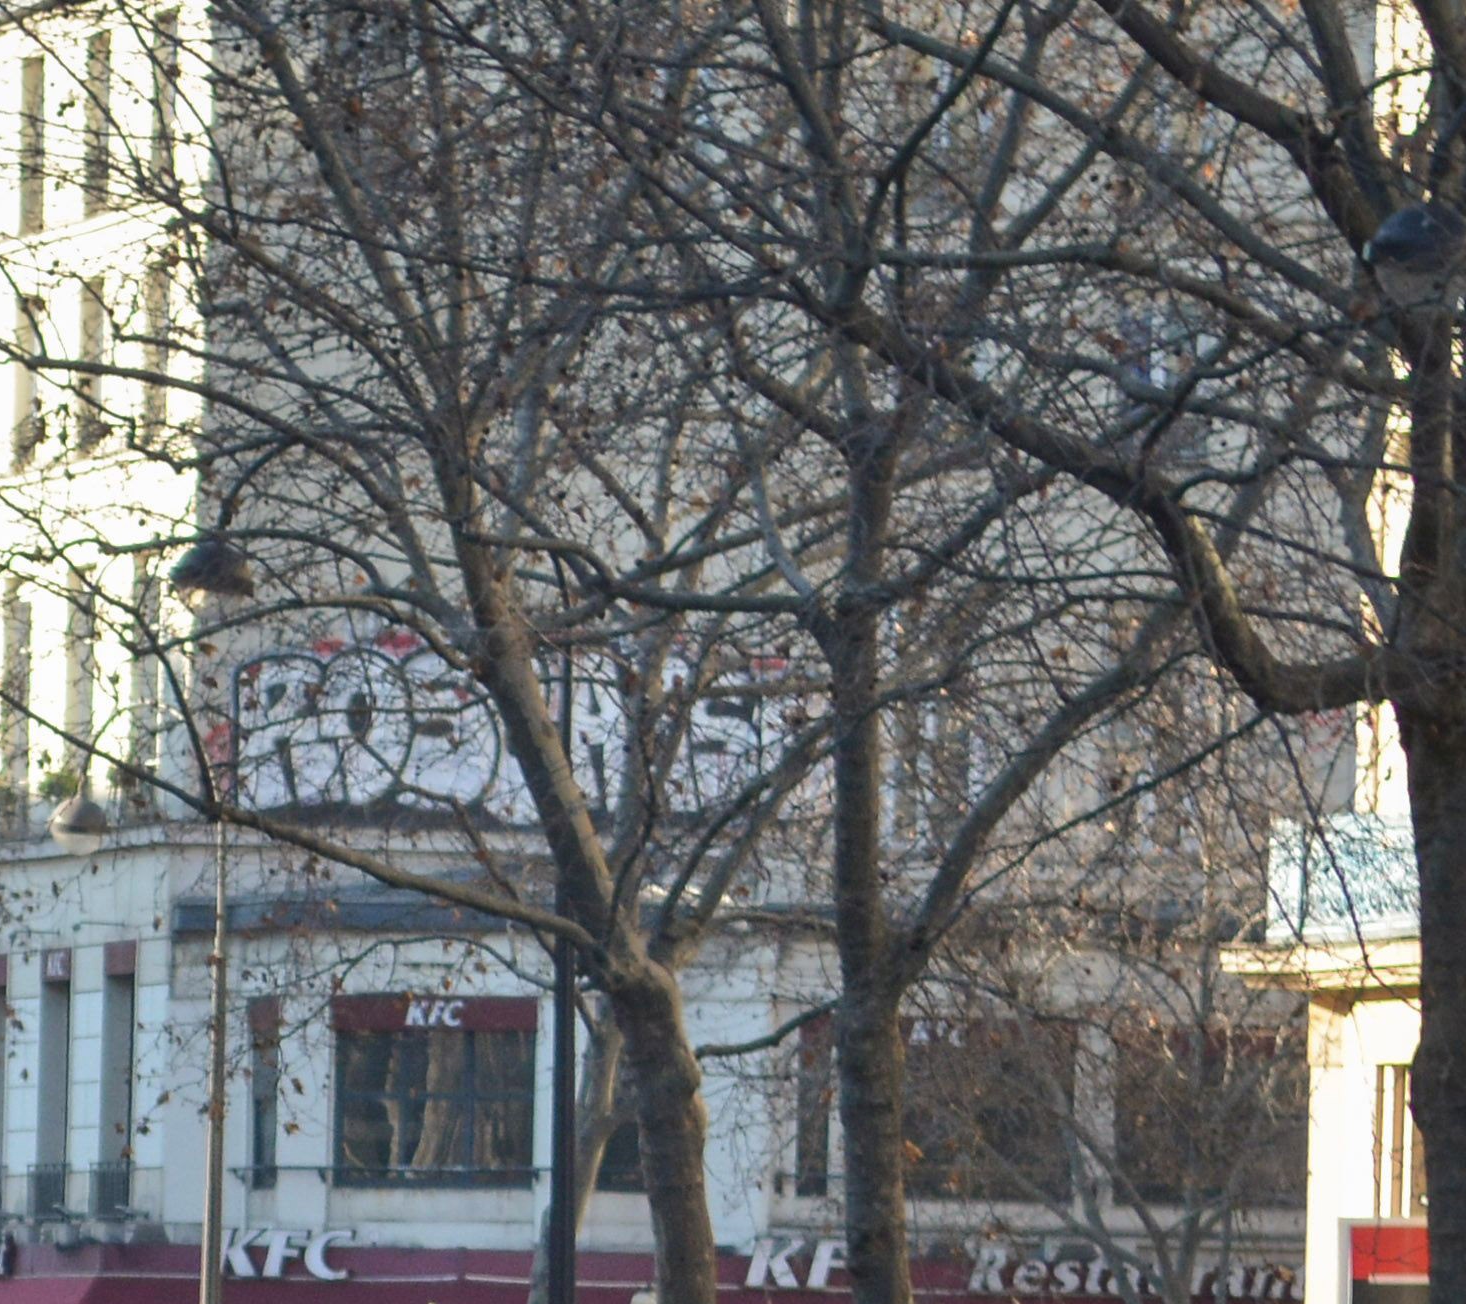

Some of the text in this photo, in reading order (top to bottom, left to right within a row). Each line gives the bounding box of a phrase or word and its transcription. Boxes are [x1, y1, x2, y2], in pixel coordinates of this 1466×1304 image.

[405, 1000, 465, 1027] KFC
[220, 1228, 356, 1280] KFC
[745, 1236, 849, 1290] KF
